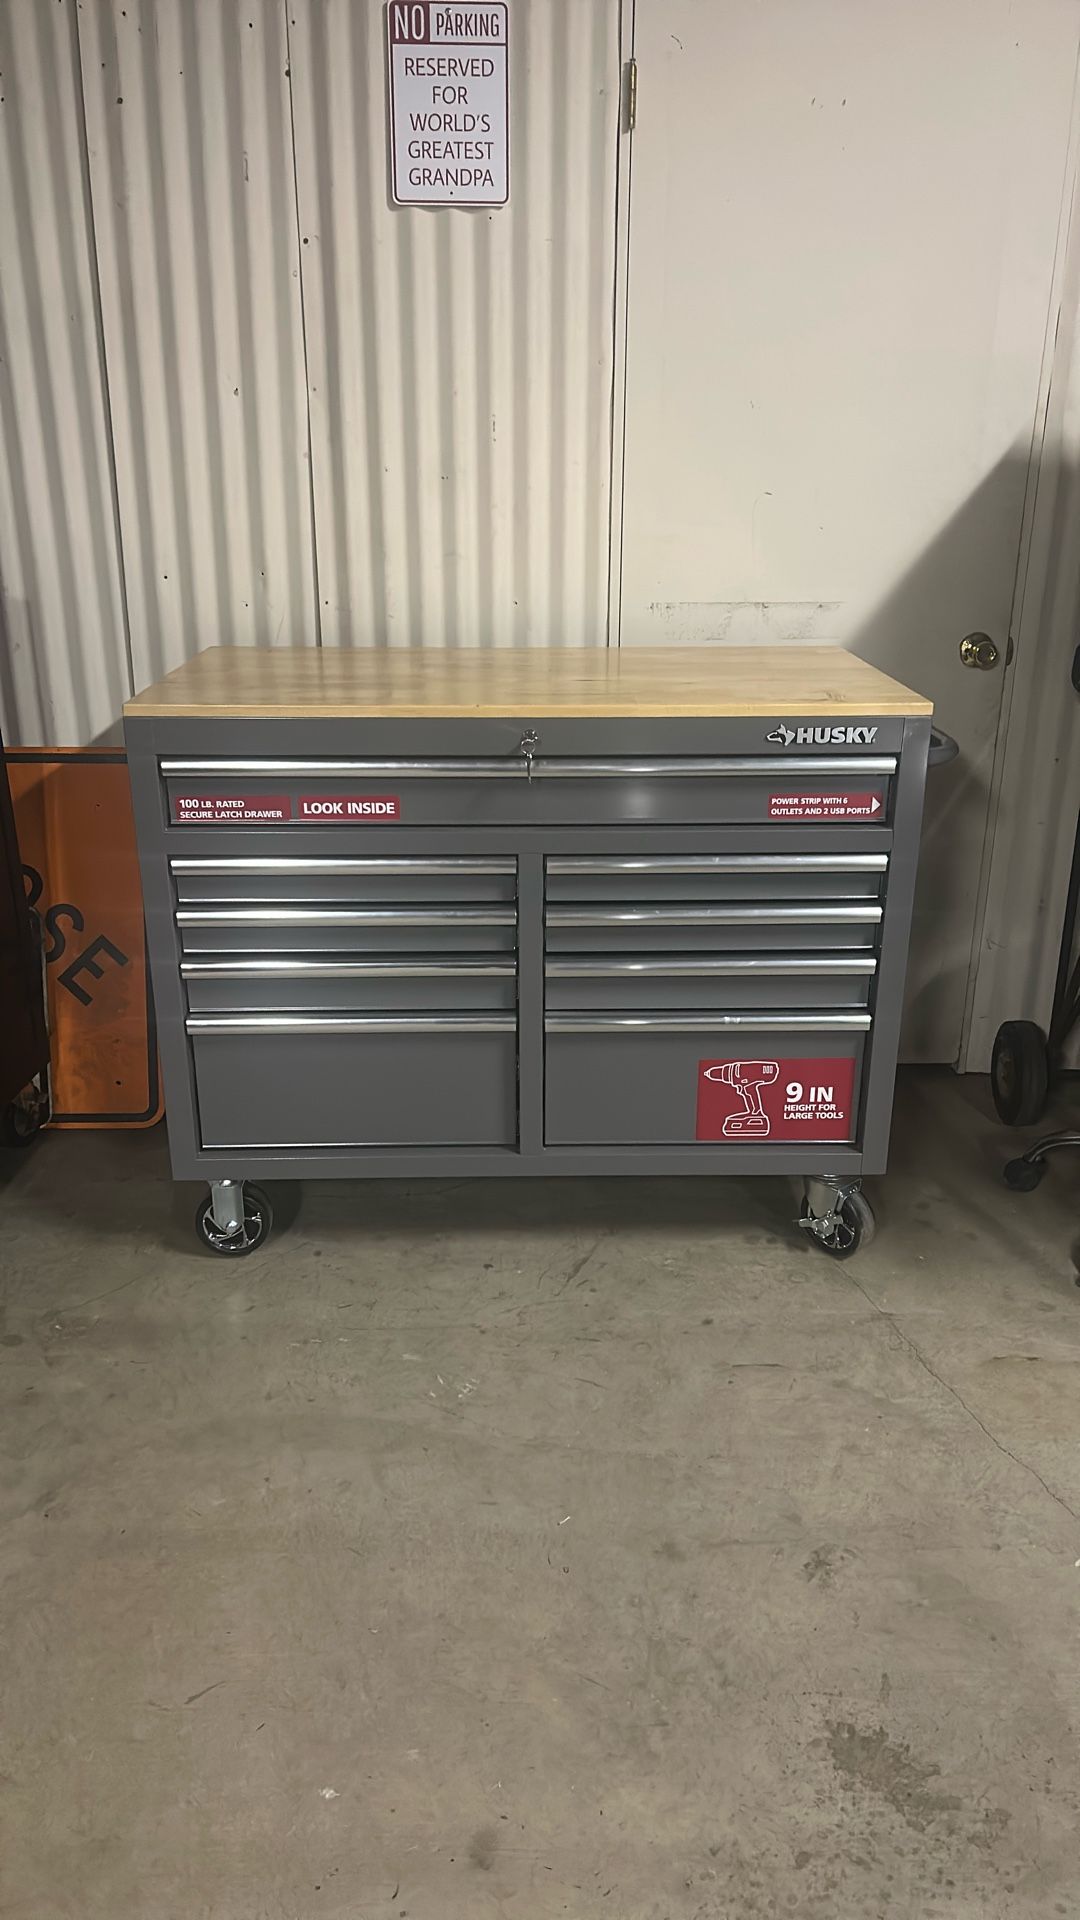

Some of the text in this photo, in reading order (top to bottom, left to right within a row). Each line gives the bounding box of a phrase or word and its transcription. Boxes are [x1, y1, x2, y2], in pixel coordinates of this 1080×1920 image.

[394, 4, 500, 40] NO PARKING
[404, 57, 495, 78] RESERVED
[432, 85, 469, 105] FOR
[409, 112, 491, 133] WORLD'S
[407, 140, 495, 160] GREATEST
[408, 168, 495, 187] GRANDPA
[796, 727, 878, 744] HUSKY
[179, 799, 245, 809] 100 LB. RATED
[303, 802, 395, 815] LOOK INSIDE
[771, 797, 848, 805] POWER STRIP WITH 6
[179, 810, 283, 819] SECURE LATCH DRAWER
[770, 807, 871, 815] OUTLETS AND 2 USB PORTS
[785, 1082, 834, 1103] 9 IN
[783, 1112, 814, 1120] LARGE
[784, 1104, 816, 1112] HEIGHT
